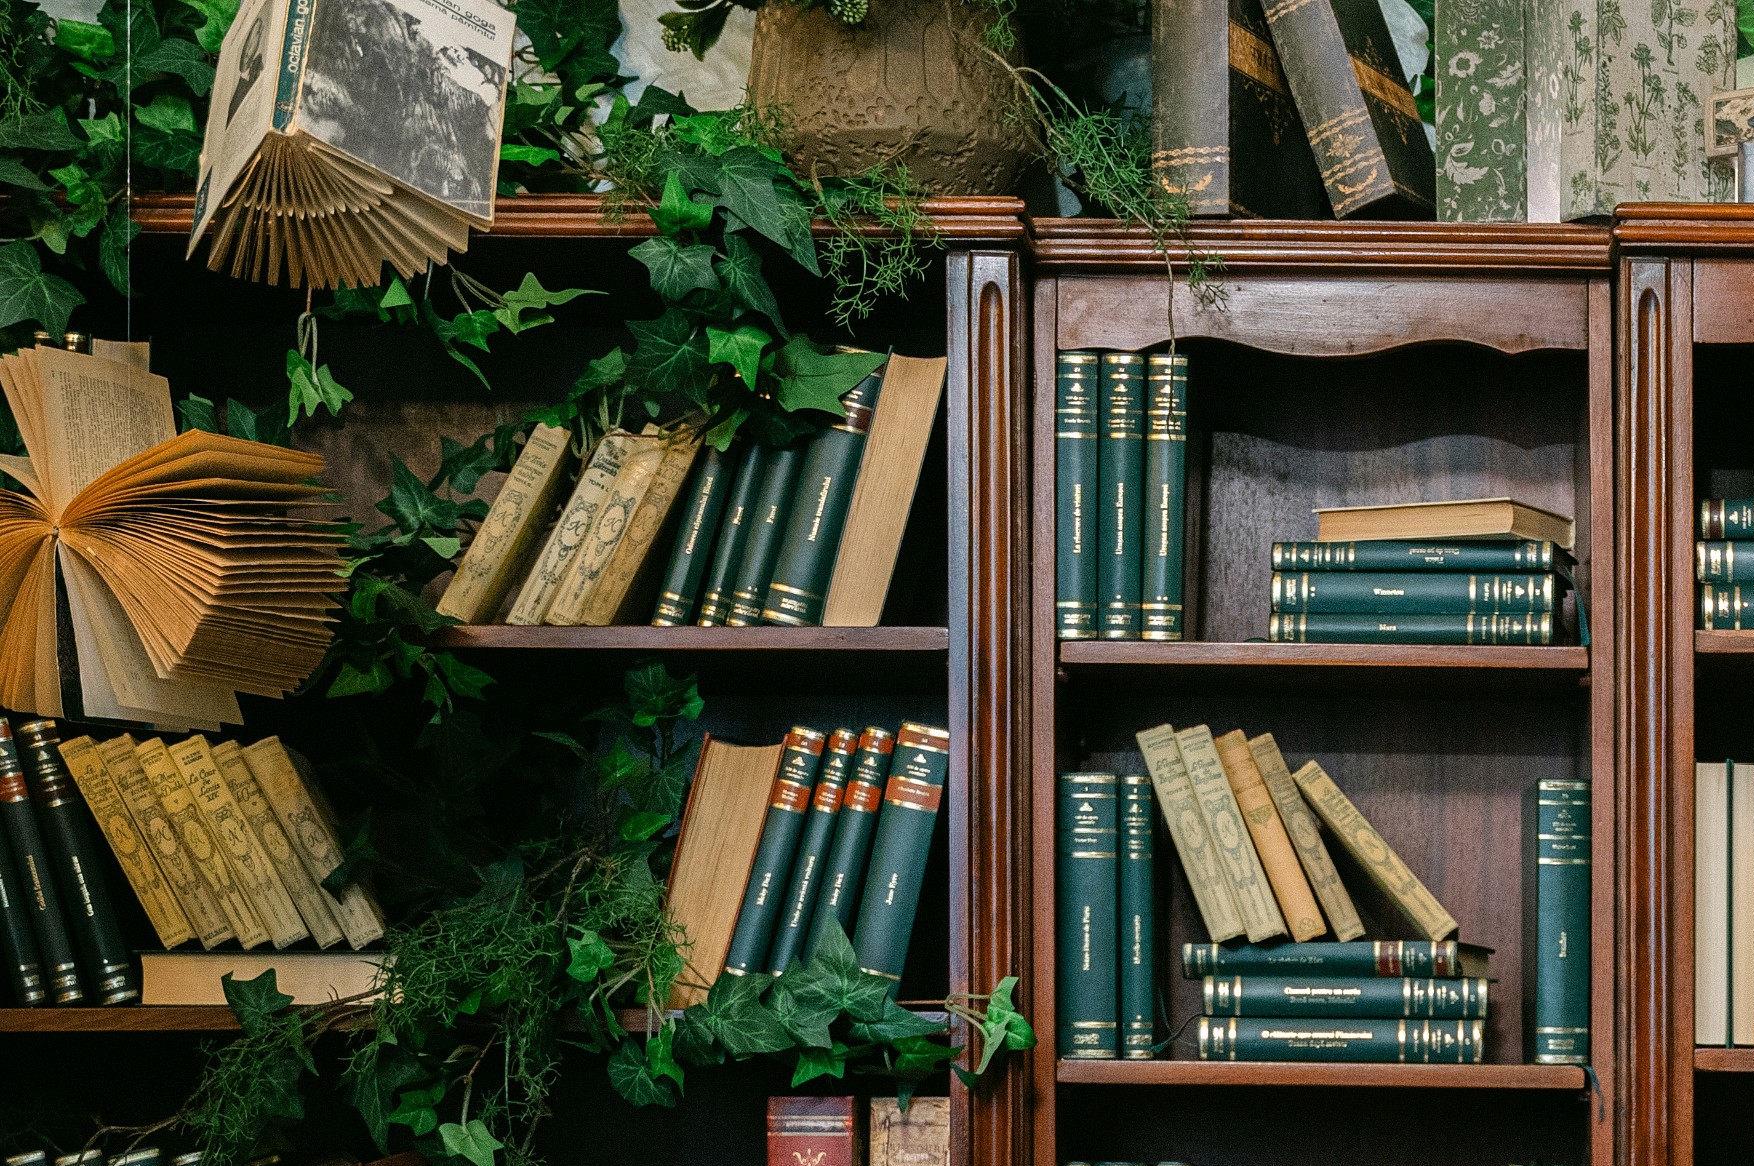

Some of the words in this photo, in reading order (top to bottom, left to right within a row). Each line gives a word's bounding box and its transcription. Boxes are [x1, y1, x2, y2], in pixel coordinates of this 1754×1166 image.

[286, 18, 305, 73] octavian
[297, 0, 310, 16] go
[463, 9, 497, 32] goga
